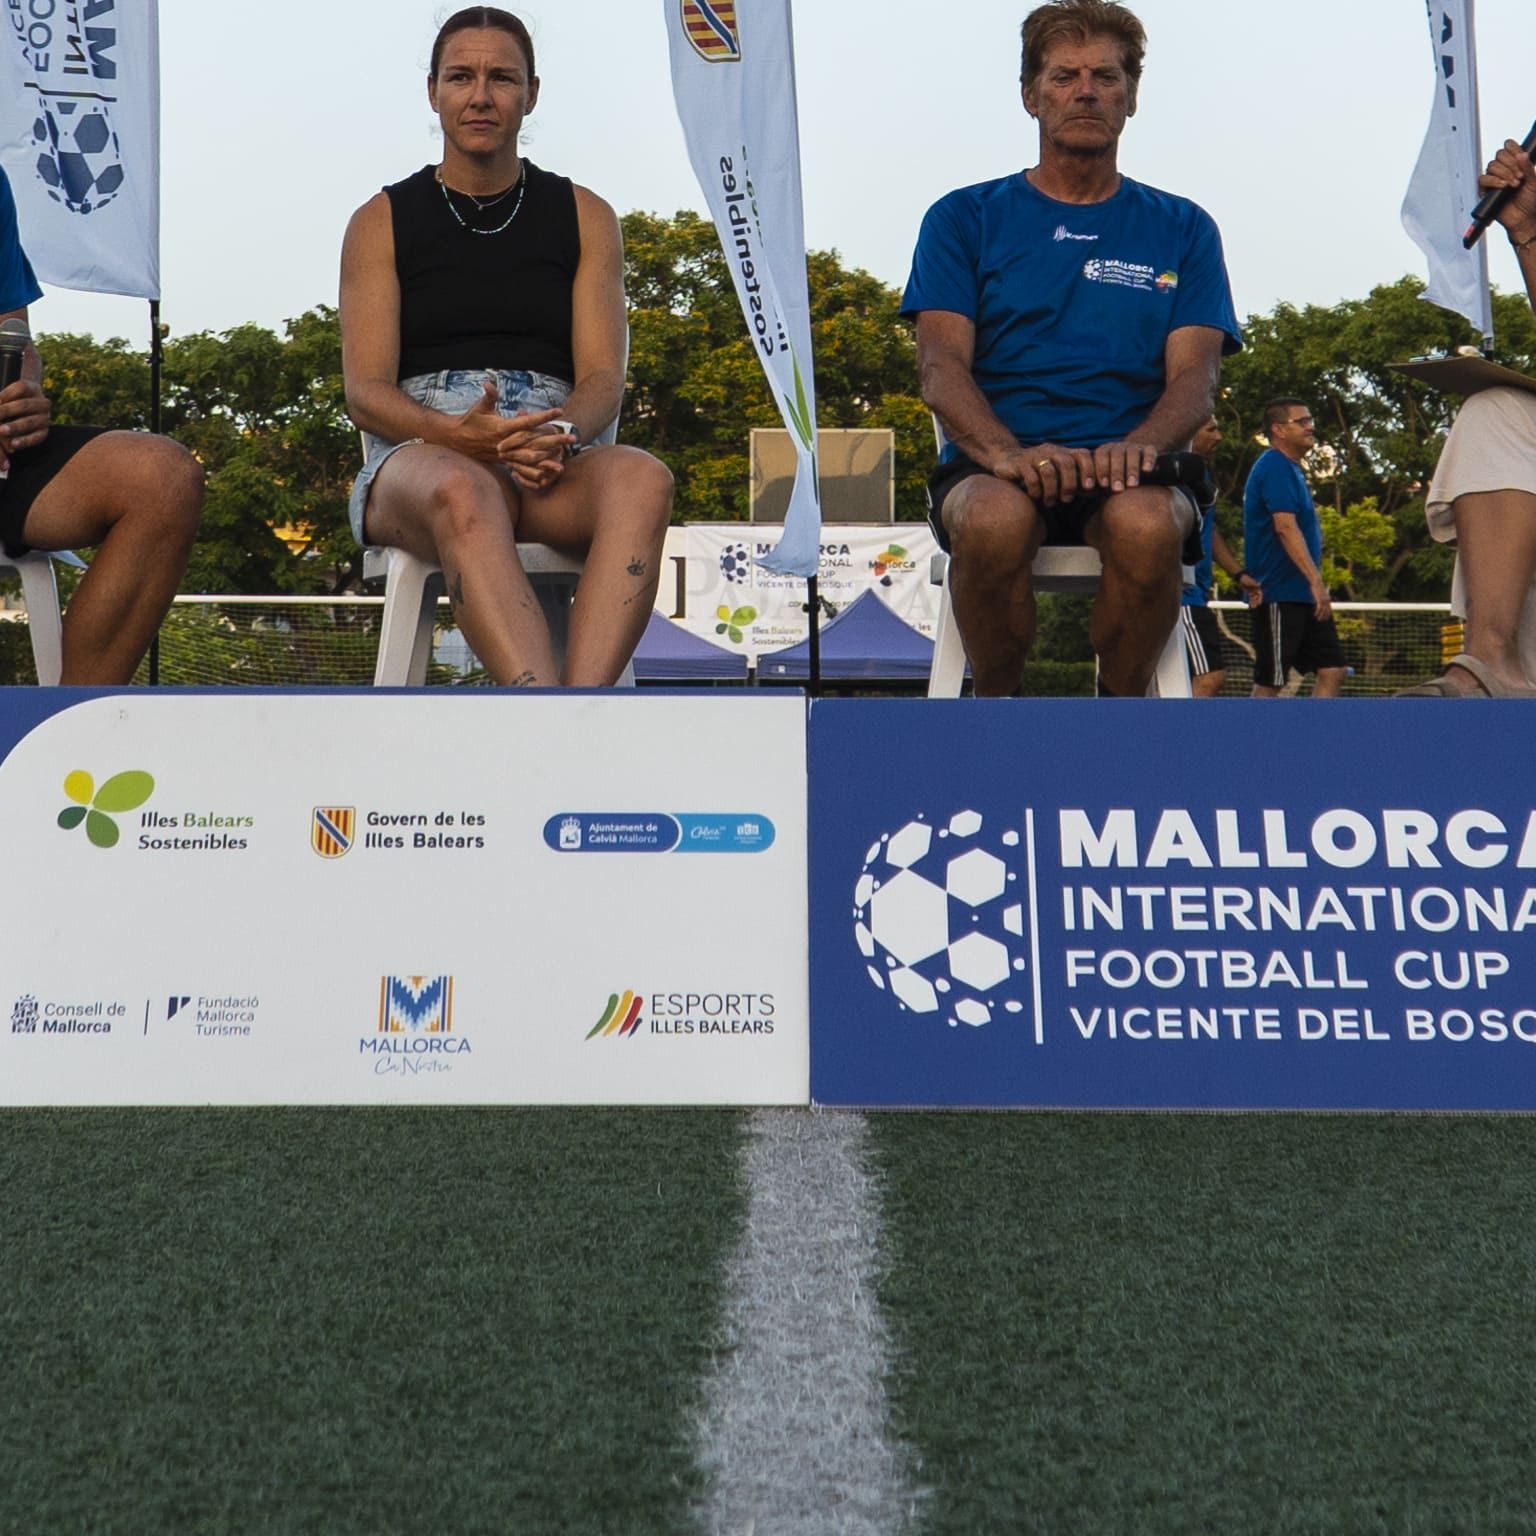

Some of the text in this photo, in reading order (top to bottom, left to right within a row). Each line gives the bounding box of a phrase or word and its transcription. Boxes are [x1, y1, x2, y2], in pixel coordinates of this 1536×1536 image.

[1105, 260, 1154, 273] MALLORCA
[869, 560, 916, 569] Mallorca
[140, 812, 254, 828] Illes Balears
[367, 811, 486, 827] Govern de les
[589, 823, 658, 834] Ajuntament de
[138, 834, 248, 850] Sostenibles
[365, 833, 485, 849] Illes Balears
[619, 834, 658, 844] Mallorca
[1066, 950, 1510, 990] FOOTBALL CUP
[197, 996, 260, 1008] Fundació
[652, 994, 775, 1016] ESPORTS
[44, 1002, 126, 1017] Consell de
[196, 1009, 255, 1022] Mallorca
[42, 1020, 111, 1033] Mallorca
[196, 1024, 251, 1036] Turisme
[651, 1020, 774, 1034] ILLES BALEARS
[1070, 1007, 1283, 1040] VICENTE
[1297, 1008, 1390, 1041] DEL
[360, 1038, 472, 1054] MALLORCA
